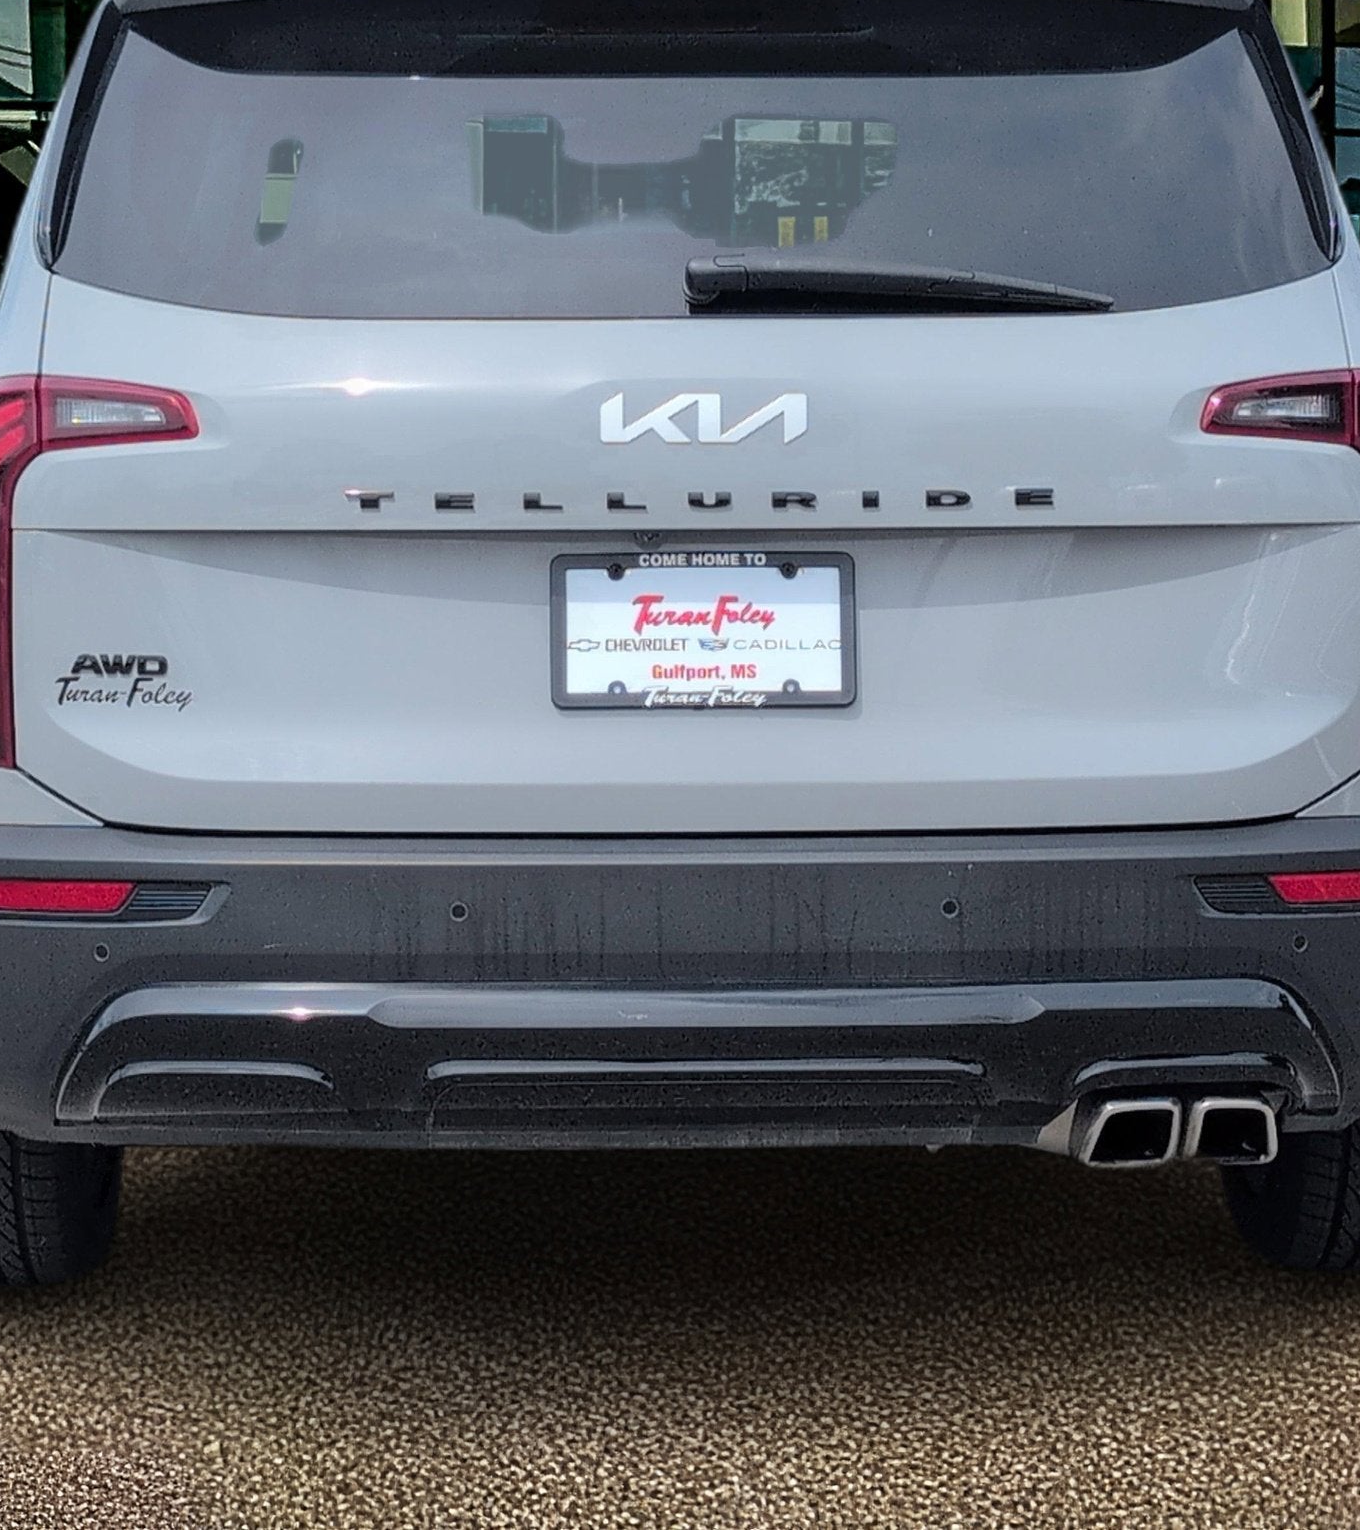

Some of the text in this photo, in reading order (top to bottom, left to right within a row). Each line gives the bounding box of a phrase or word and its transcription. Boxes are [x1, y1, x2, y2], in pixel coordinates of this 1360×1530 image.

[344, 487, 1055, 513] TELLURIDE
[639, 552, 767, 566] COME HOME TO
[605, 638, 842, 652] CHEVROLET CADILLAC
[71, 654, 168, 676] AWD
[651, 664, 757, 681] Gulfport, MS
